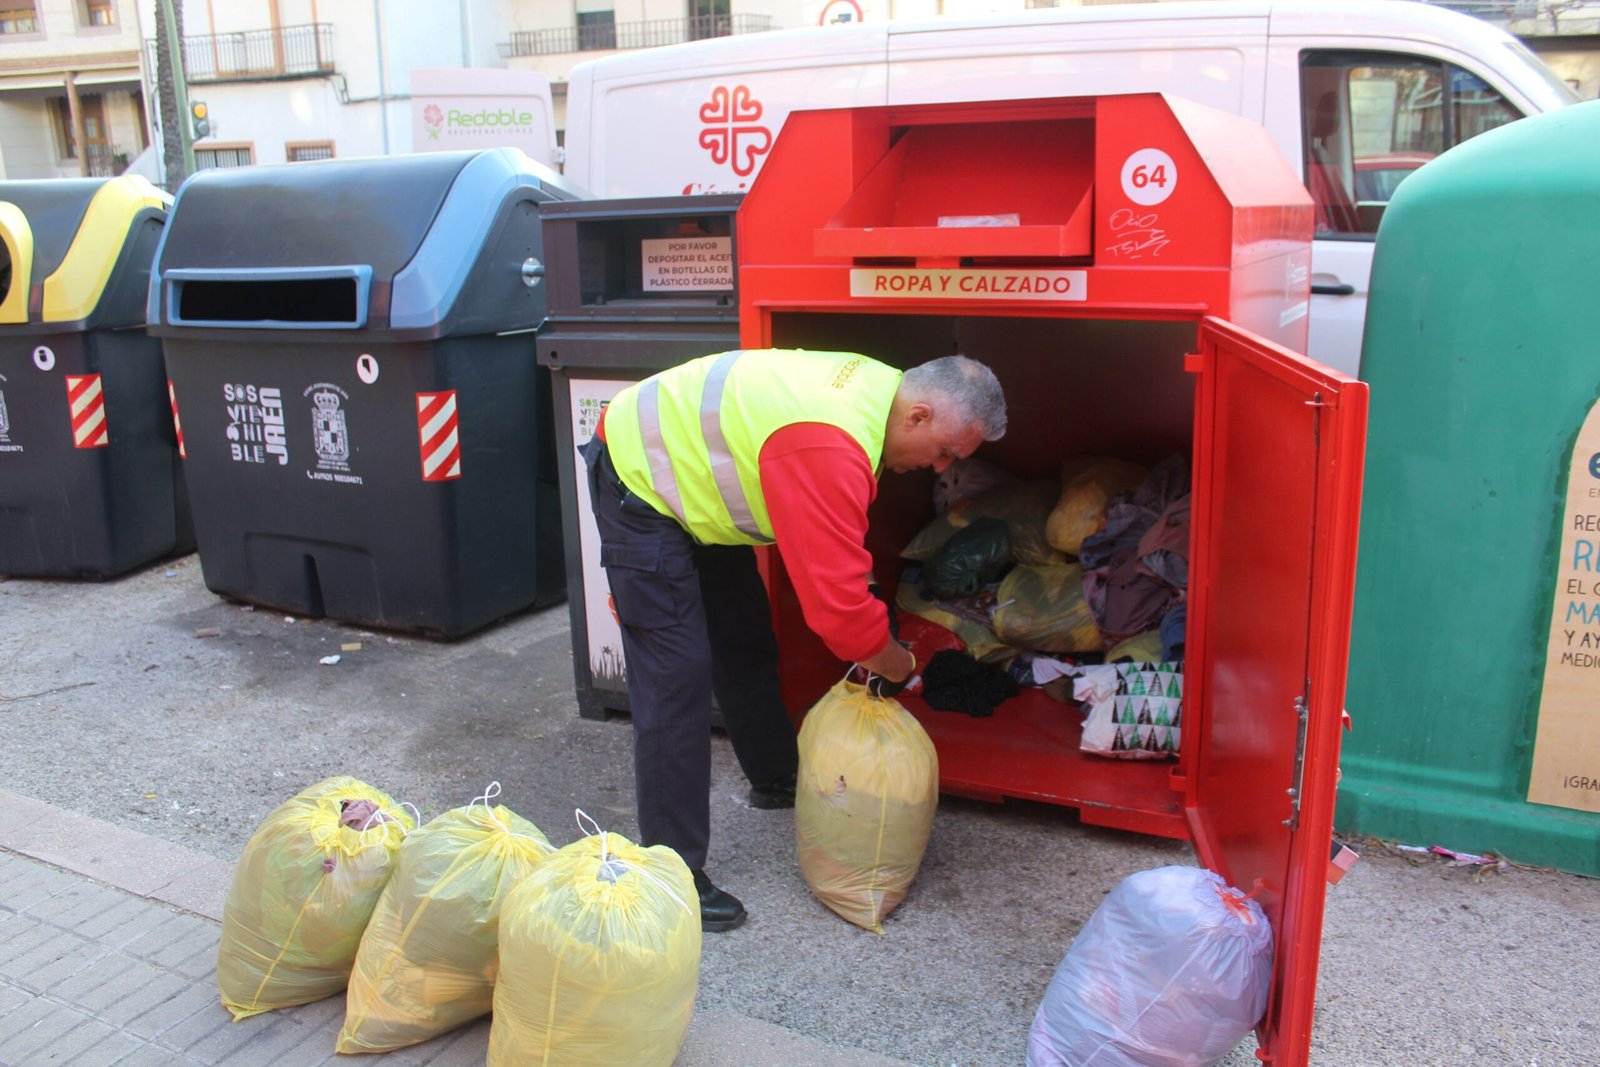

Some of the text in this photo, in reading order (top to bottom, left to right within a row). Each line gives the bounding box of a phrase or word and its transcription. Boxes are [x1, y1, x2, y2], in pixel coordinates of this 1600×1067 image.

[447, 107, 533, 127] Redoble
[1132, 164, 1167, 188] 64
[668, 242, 717, 251] POR FAVOR
[648, 255, 695, 263] DEPOSITAR
[697, 254, 708, 262] EL
[658, 265, 729, 275] EN BOTELLAS DE
[650, 277, 690, 287] PLÁSTICO
[874, 275, 1071, 294] ROPA Y CALZADO
[223, 383, 258, 403] SOS
[1574, 514, 1600, 532] RE
[1567, 579, 1587, 595] EL
[1564, 629, 1575, 646] Y
[1560, 652, 1600, 669] MEDI
